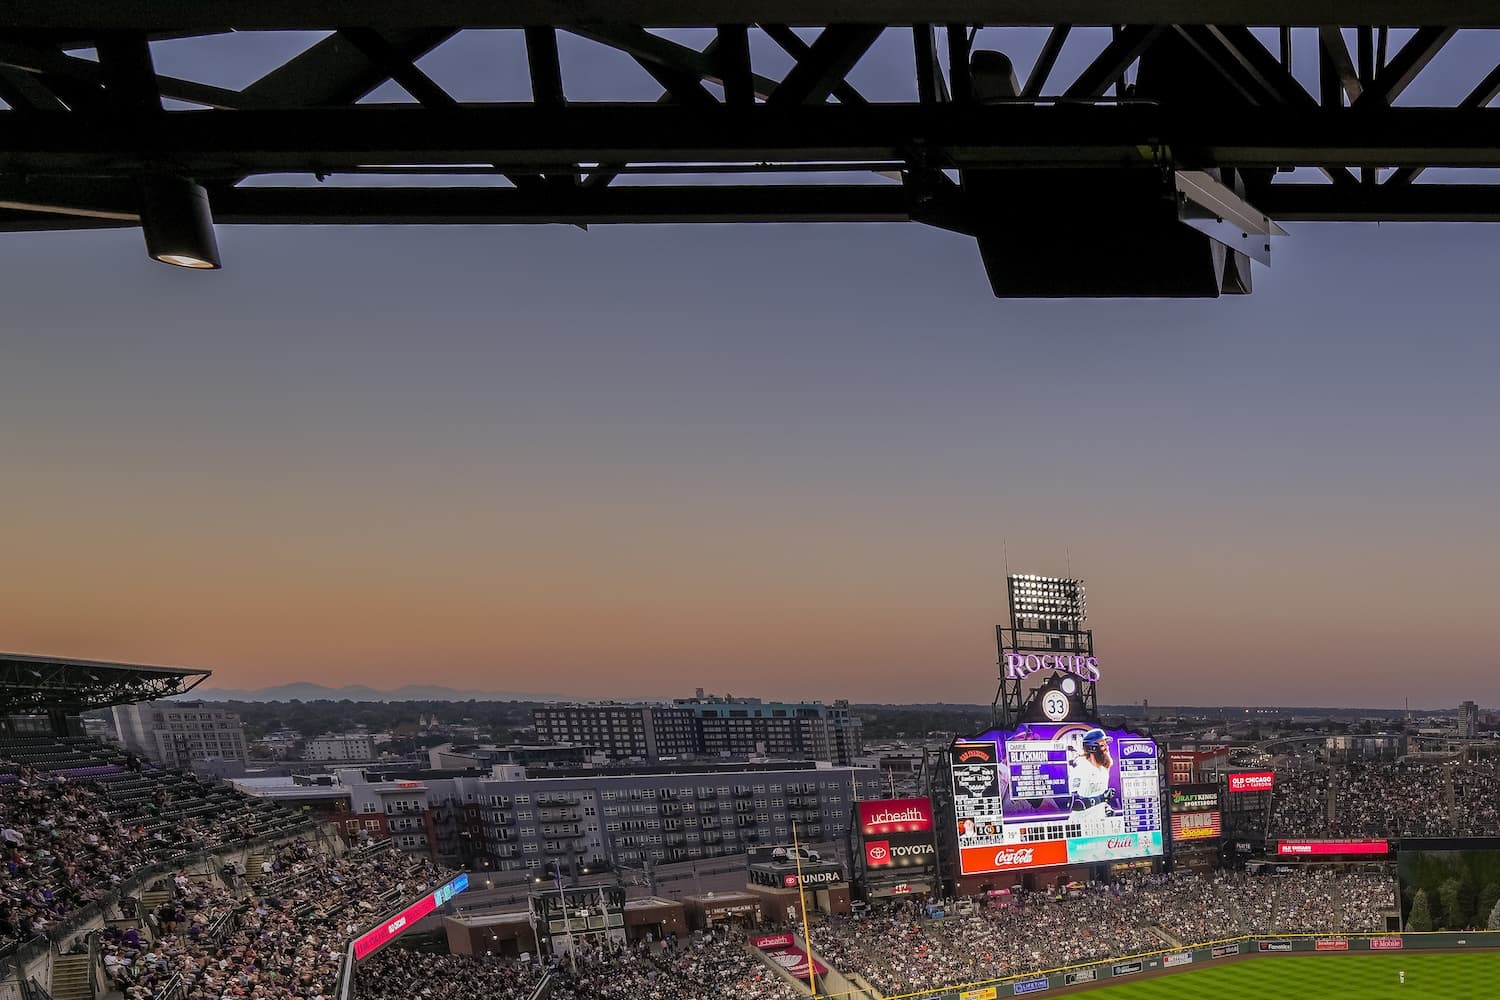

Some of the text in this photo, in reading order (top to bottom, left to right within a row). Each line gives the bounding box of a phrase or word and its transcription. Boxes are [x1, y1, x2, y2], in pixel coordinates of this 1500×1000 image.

[1004, 652, 1100, 682] ROCKIES
[1047, 699, 1064, 714] 33
[1123, 743, 1154, 756] COLORADO
[1010, 751, 1048, 762] BLACKMON
[870, 808, 923, 824] uchealth
[890, 844, 935, 857] TOYOTA
[757, 935, 788, 948] uchealth
